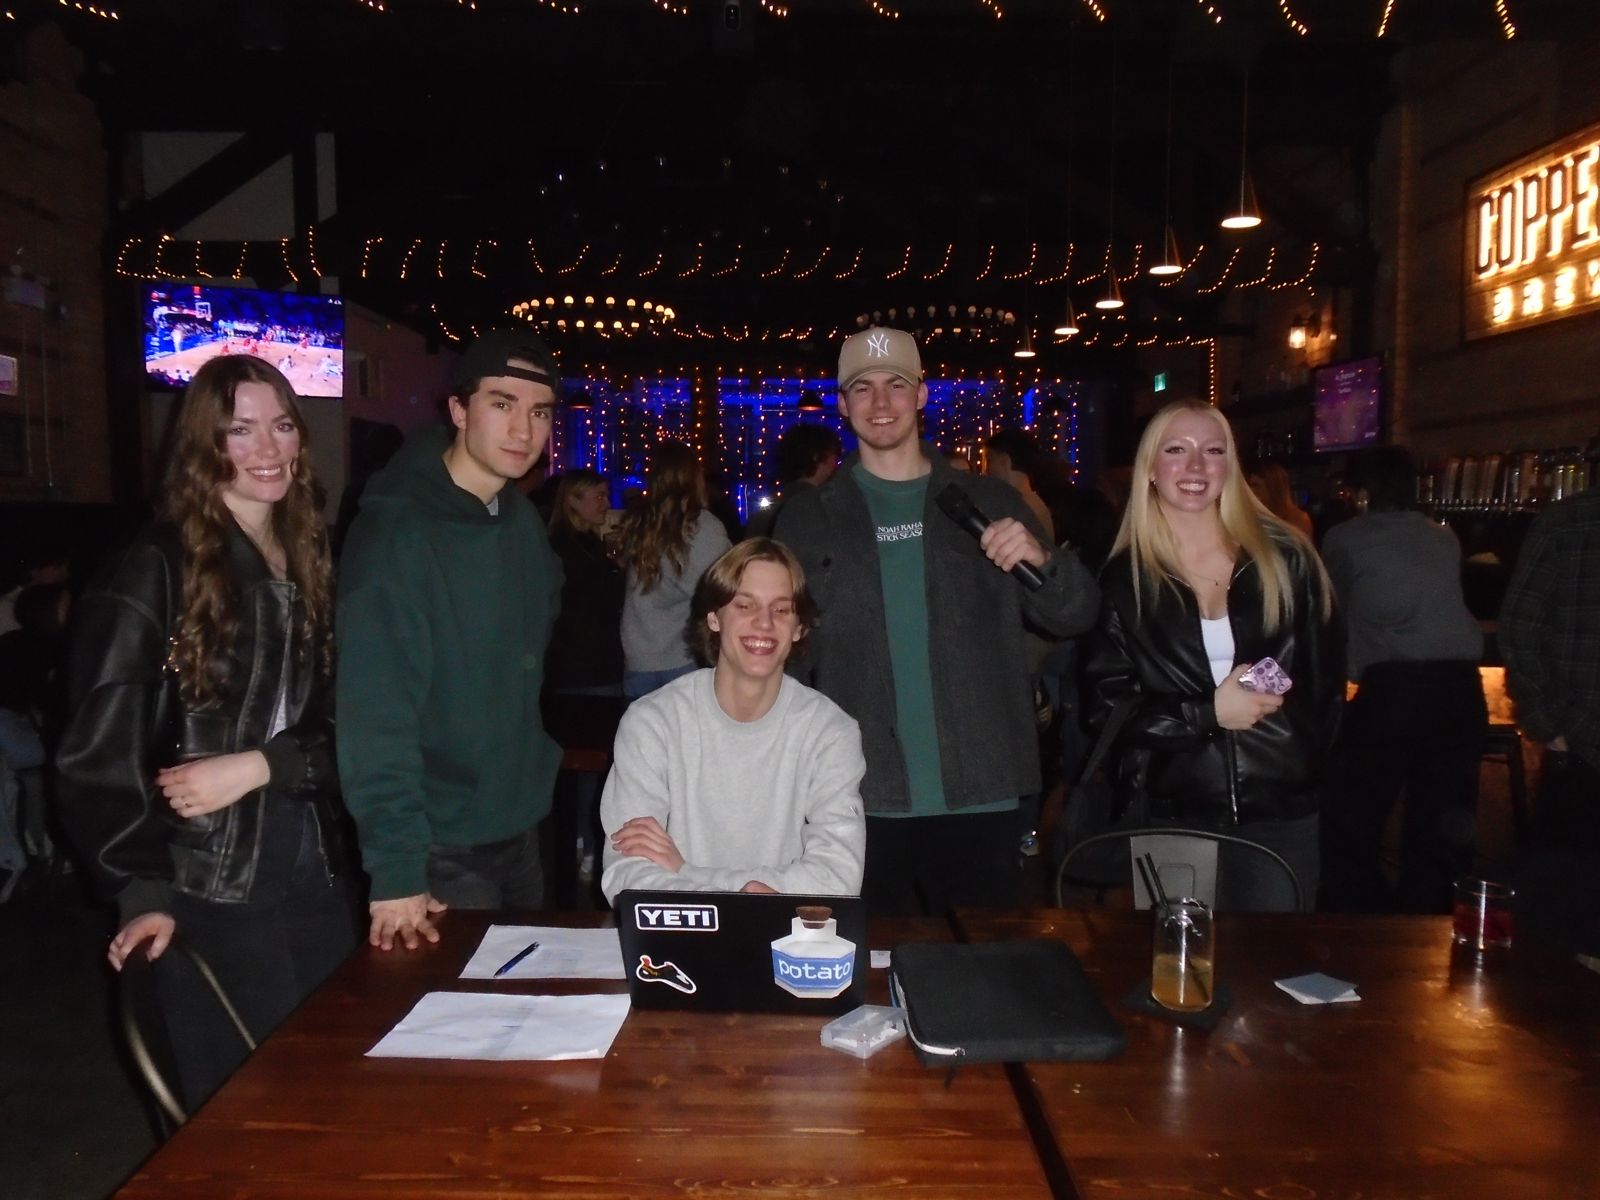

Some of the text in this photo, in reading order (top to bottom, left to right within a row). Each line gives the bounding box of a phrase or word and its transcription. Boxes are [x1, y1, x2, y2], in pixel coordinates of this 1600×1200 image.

[867, 334, 890, 357] NY
[876, 534, 899, 542] STICK
[640, 909, 710, 926] YETI
[778, 959, 851, 980] potato
